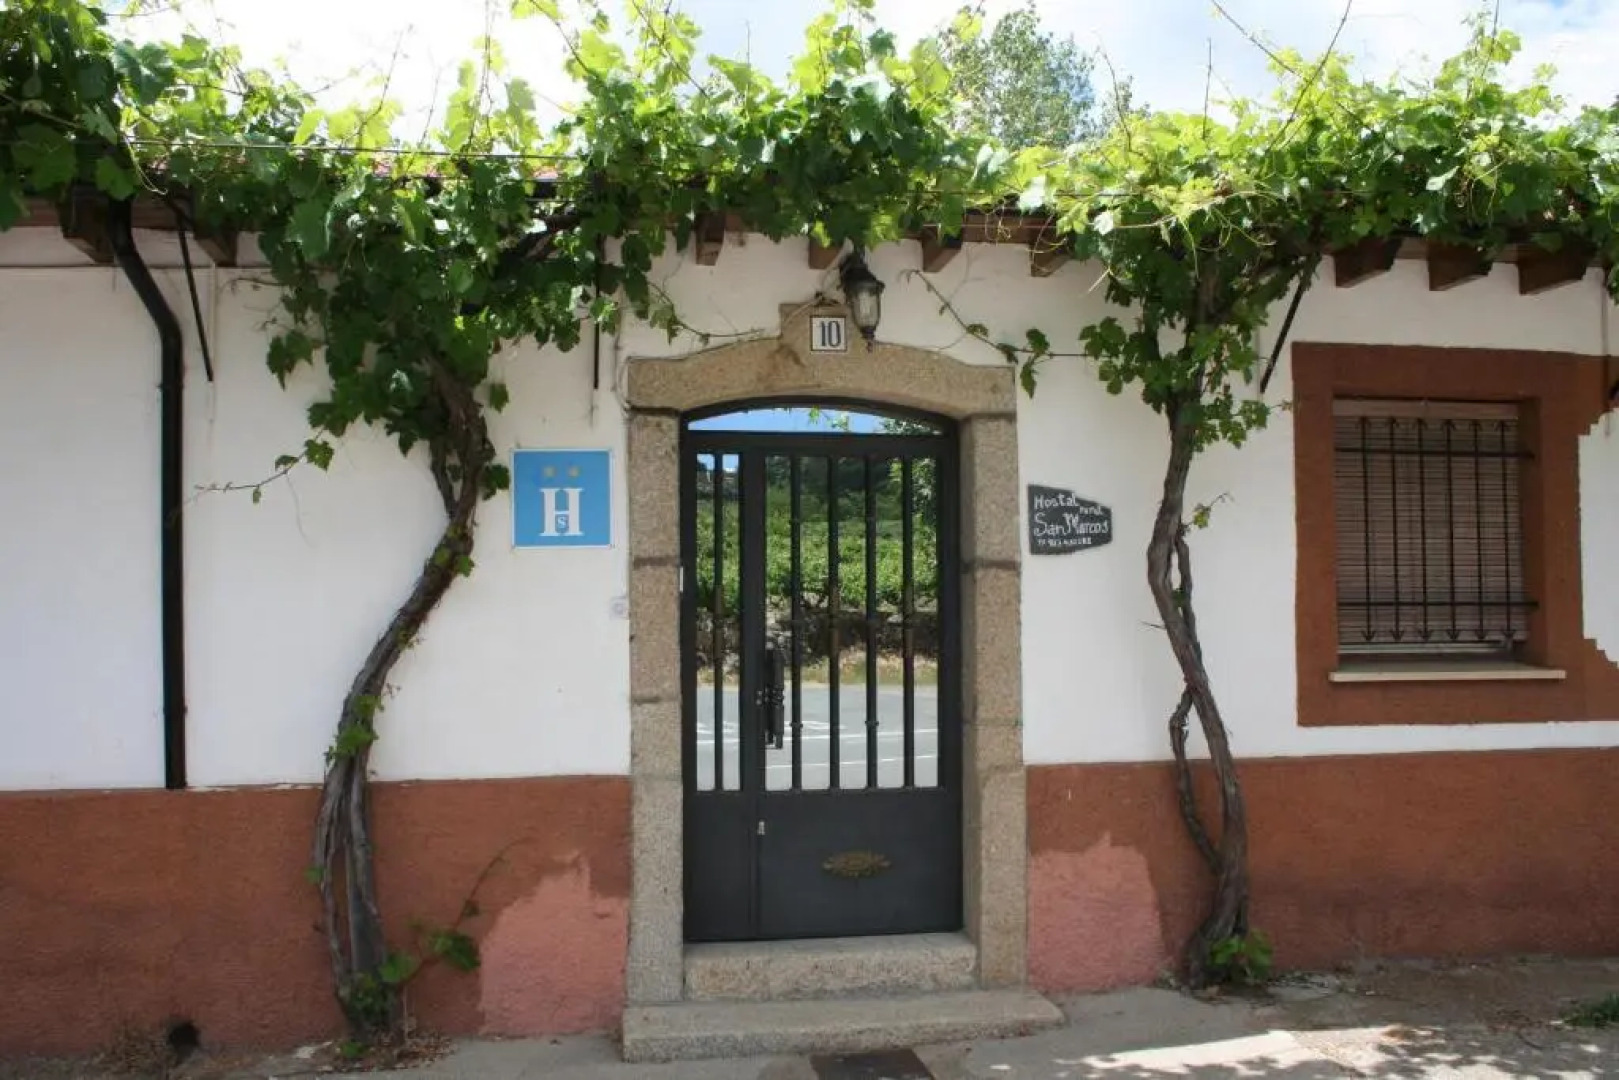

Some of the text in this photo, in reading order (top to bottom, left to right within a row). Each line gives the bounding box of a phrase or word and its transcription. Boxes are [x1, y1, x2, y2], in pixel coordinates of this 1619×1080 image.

[821, 321, 841, 347] 10
[539, 488, 584, 537] H
[1034, 493, 1080, 509] Hostal
[557, 515, 567, 529] S
[1033, 512, 1067, 536] San
